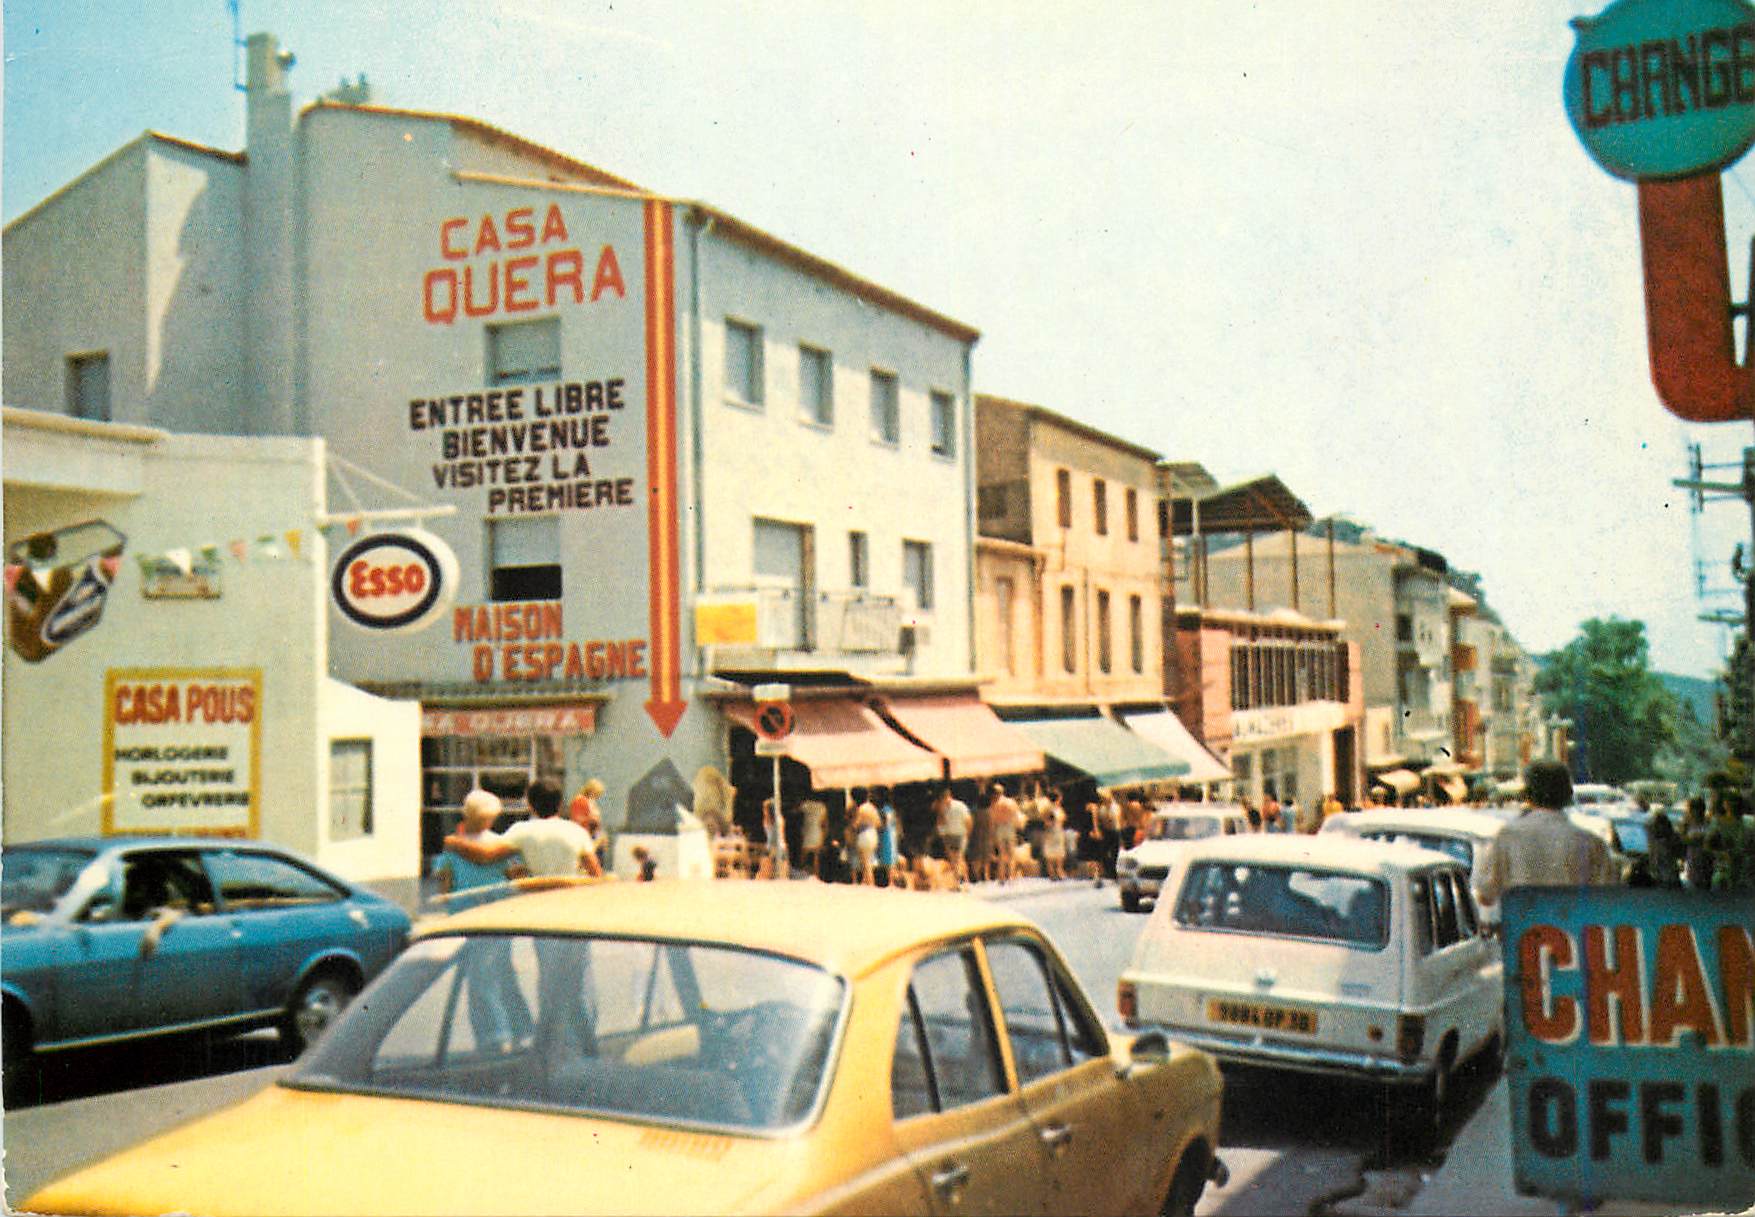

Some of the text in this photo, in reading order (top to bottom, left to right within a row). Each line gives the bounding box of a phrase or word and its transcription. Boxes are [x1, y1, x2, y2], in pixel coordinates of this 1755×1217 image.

[440, 203, 568, 260] CASA
[422, 245, 626, 324] QUERA
[409, 378, 625, 431] ENTREE LIBRE
[442, 414, 610, 459] BIENVENUE
[432, 452, 591, 489] VISITEZ LA
[488, 477, 635, 512] PREMIERE
[454, 602, 564, 641] MAISON
[115, 683, 255, 725] CASA POUS
[114, 746, 228, 761] HORLOGERIE
[131, 769, 234, 784] BIJOUTERIE
